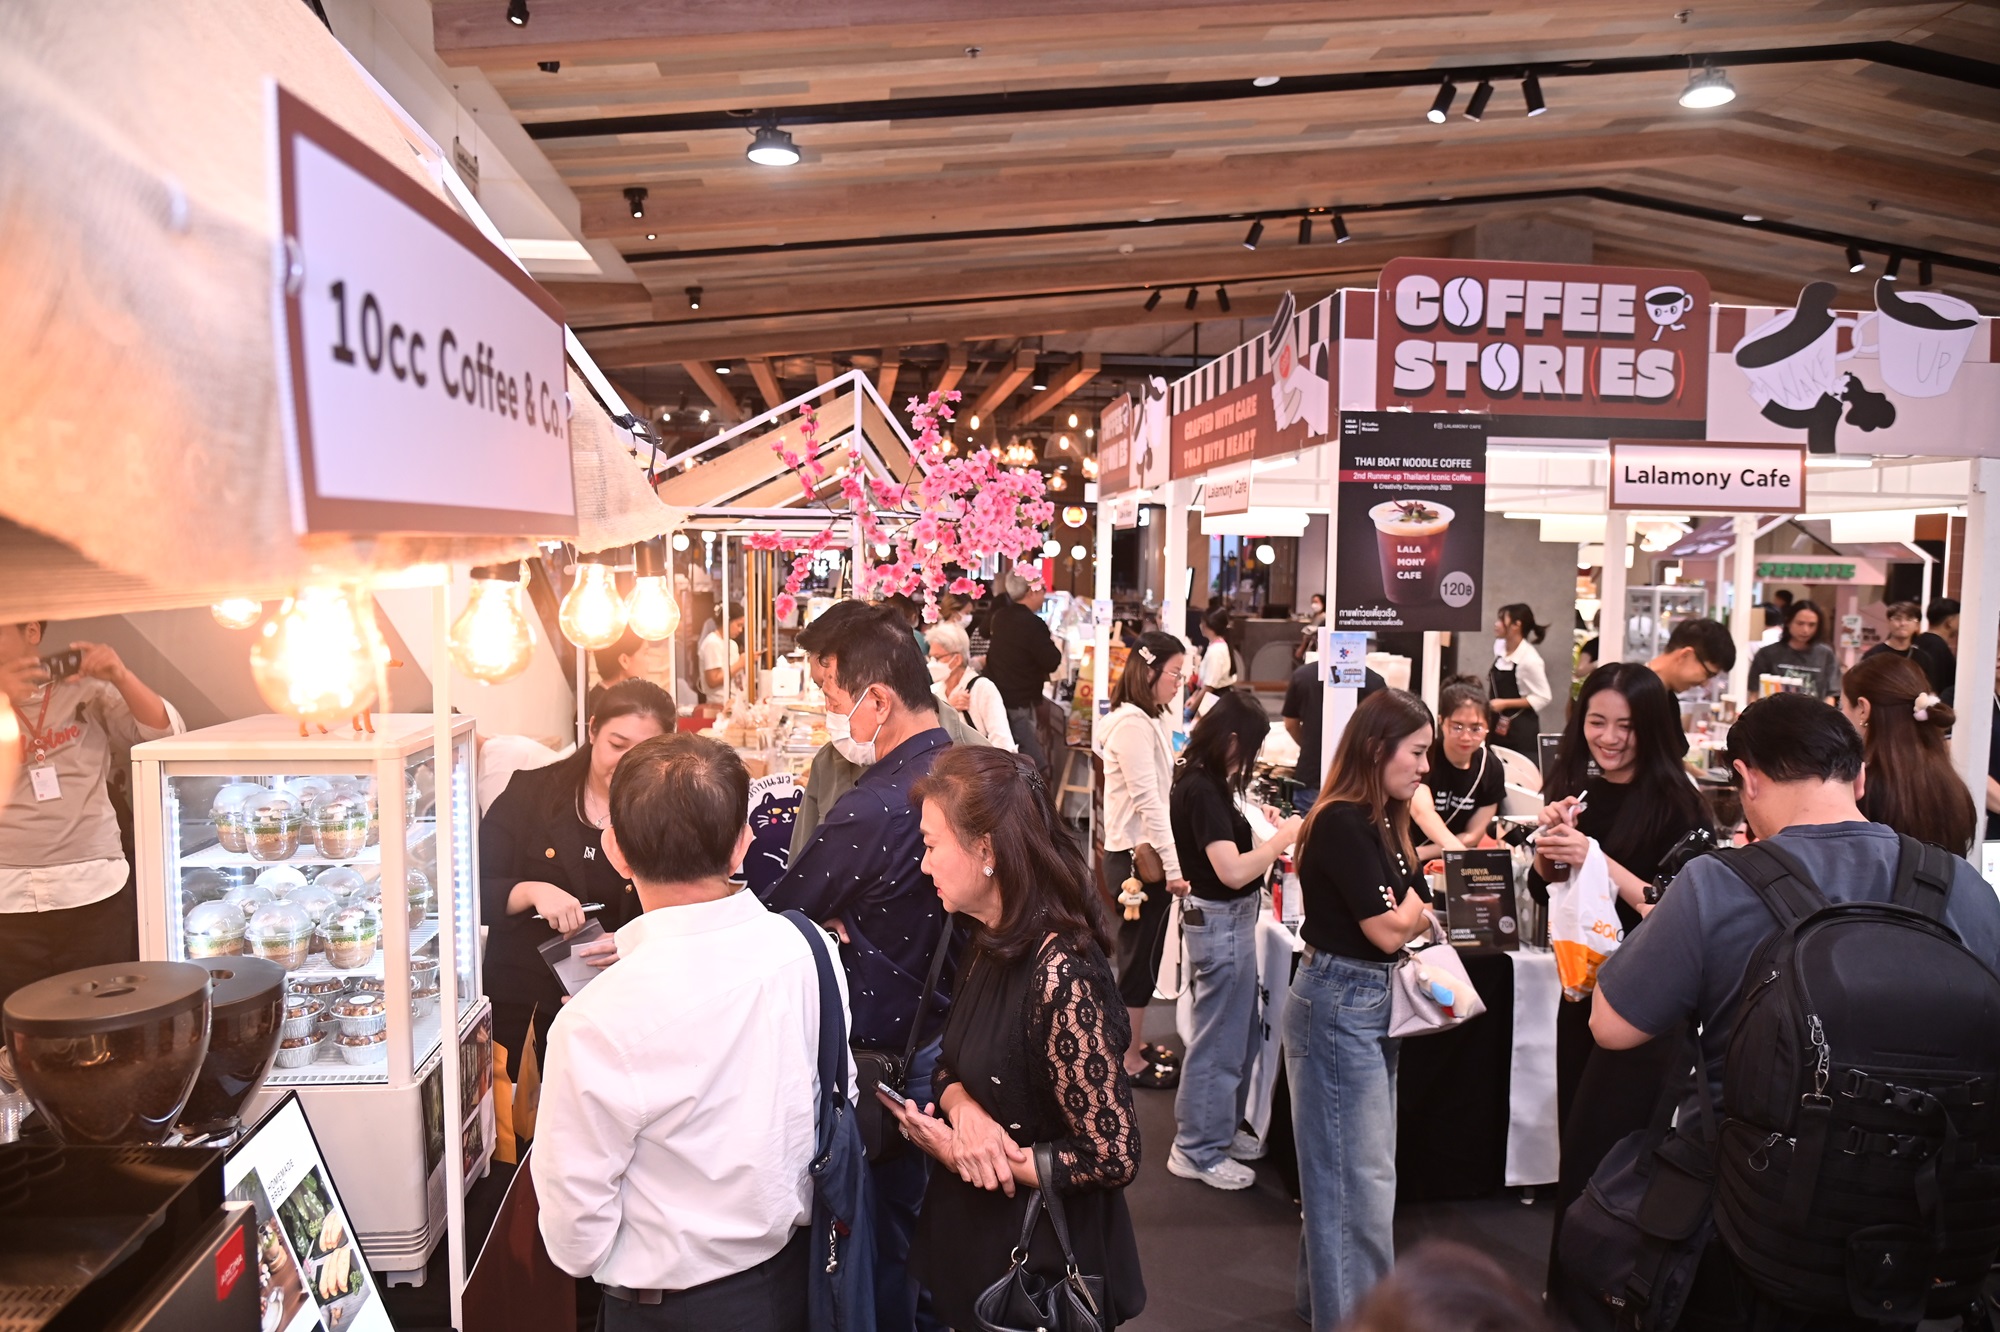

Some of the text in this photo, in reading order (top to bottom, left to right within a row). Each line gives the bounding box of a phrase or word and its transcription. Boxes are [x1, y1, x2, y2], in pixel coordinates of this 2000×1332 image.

[1394, 274, 1637, 336] COFFEE
[329, 279, 564, 440] 10cc Coffee & Co.
[1915, 340, 1951, 387] UP
[1770, 347, 1825, 406] WAKE
[1184, 394, 1258, 441] CRAFTED WITH CARE
[1184, 428, 1257, 469] TOLD WITH HEART
[1354, 457, 1472, 469] THAI BOAT NOODLE COFFEE
[1353, 472, 1366, 480] 2nd
[1367, 472, 1402, 481] Runner-up
[1403, 473, 1430, 481] Thailand
[1431, 473, 1450, 481] Iconic
[1378, 483, 1403, 491] Creativity
[1625, 465, 1791, 490] Lalamony Cafe
[1208, 477, 1247, 499] Lalamony Cafe
[1396, 545, 1422, 553] LALA
[1396, 558, 1426, 566] MONY
[1757, 562, 1856, 579] JENNIE
[1396, 571, 1422, 579] CAFE
[267, 1158, 294, 1192] HOMEMADE
[271, 1181, 287, 1203] BREAD
